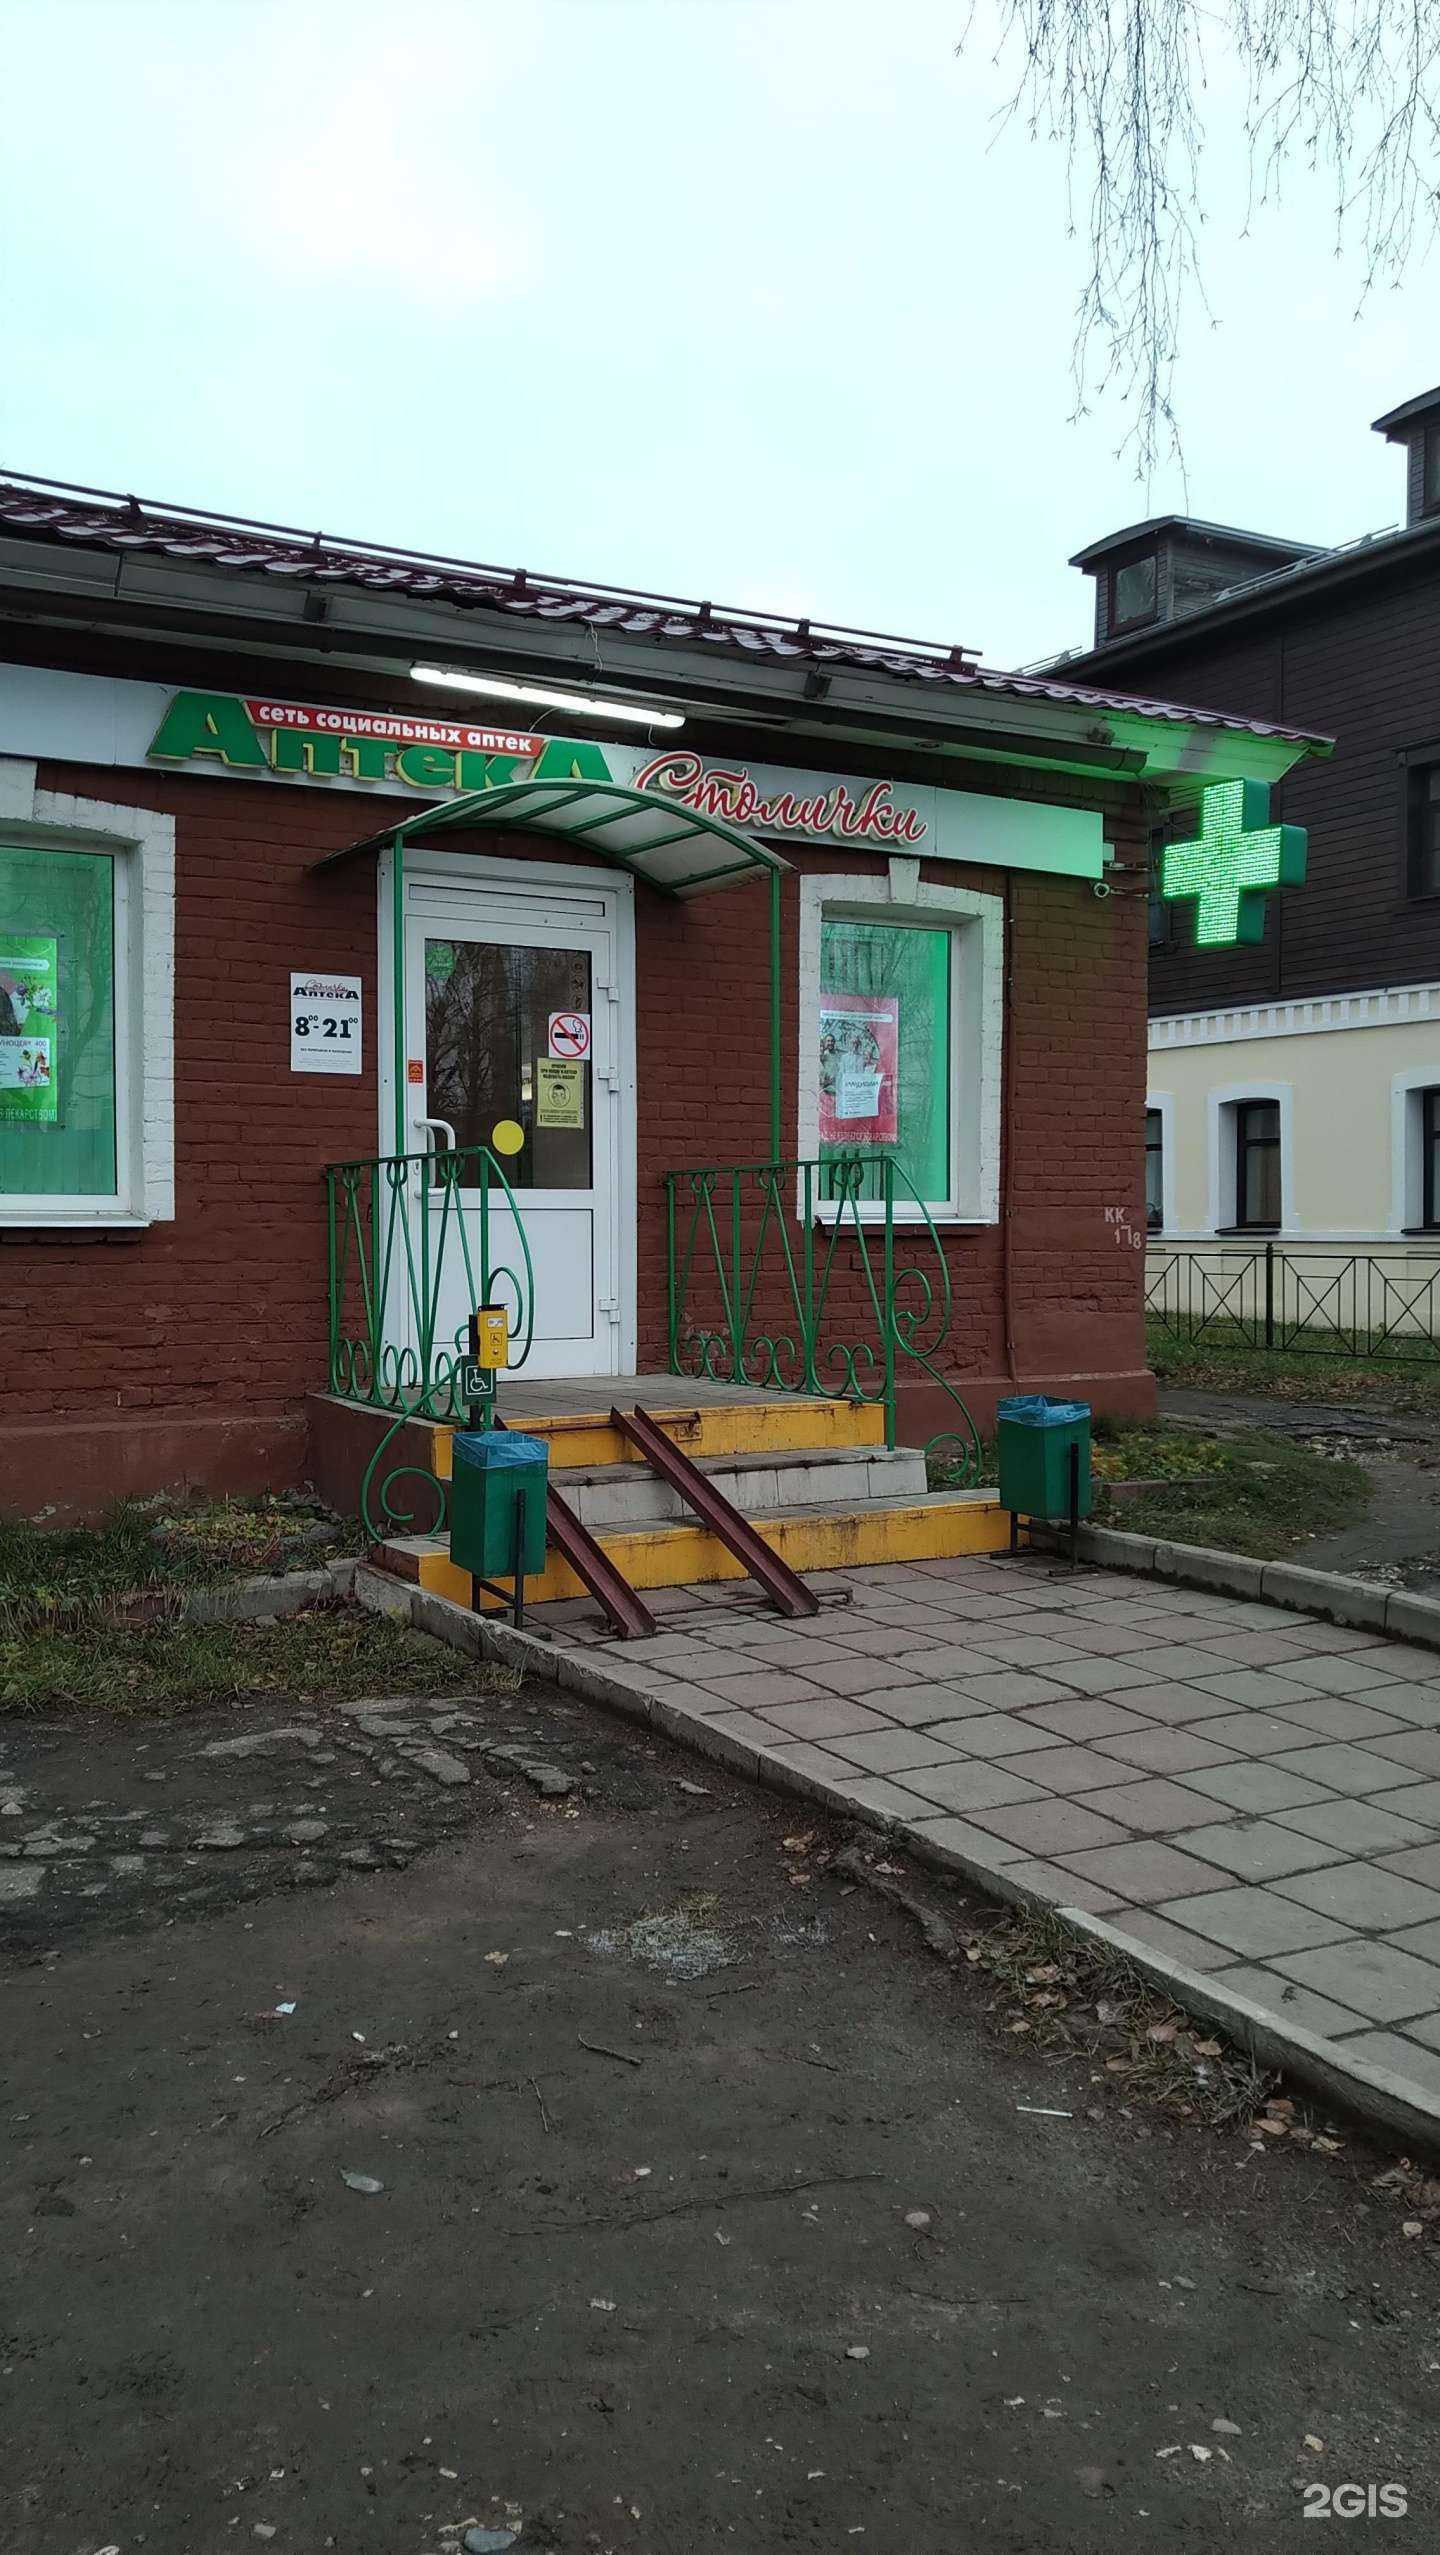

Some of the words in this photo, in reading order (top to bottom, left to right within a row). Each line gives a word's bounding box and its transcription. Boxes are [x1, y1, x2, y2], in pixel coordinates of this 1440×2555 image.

[258, 704, 309, 726] сеть
[316, 712, 461, 744] социальных
[467, 731, 532, 753] аптек
[632, 751, 927, 846] Столички
